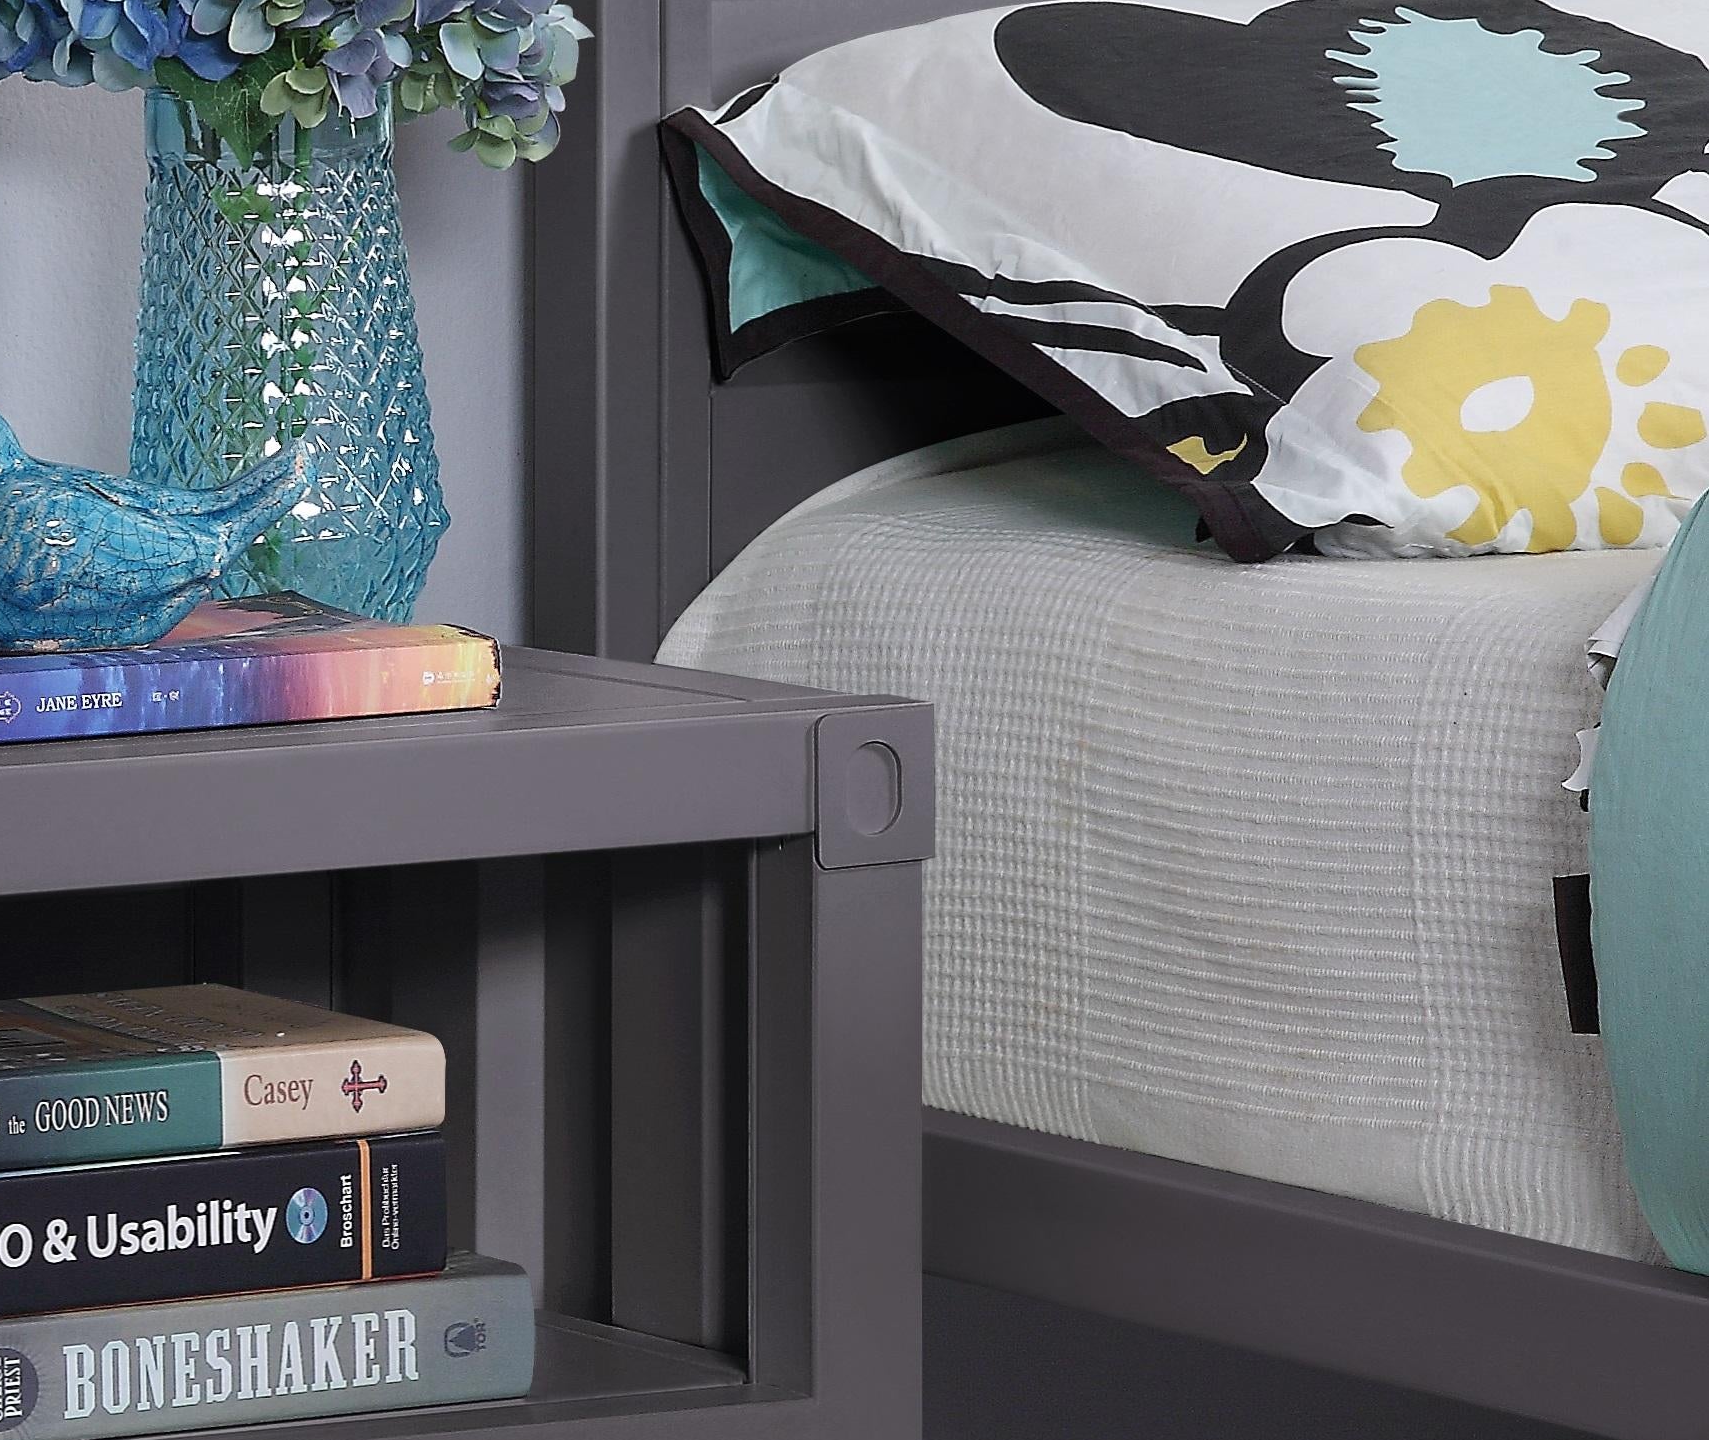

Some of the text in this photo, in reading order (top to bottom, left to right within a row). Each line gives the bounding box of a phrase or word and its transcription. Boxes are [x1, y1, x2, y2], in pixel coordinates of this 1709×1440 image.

[36, 691, 123, 713] JANE EYRE
[7, 1115, 26, 1135] the
[34, 1096, 100, 1134] GOOD
[104, 1090, 169, 1127] NEWS
[243, 1073, 315, 1111] Casey
[42, 1219, 78, 1263] &
[86, 1199, 278, 1258] Usability
[340, 1174, 352, 1248] Broschart
[4, 1356, 23, 1419] PRIEST
[62, 1309, 420, 1420] BONESHAKER
